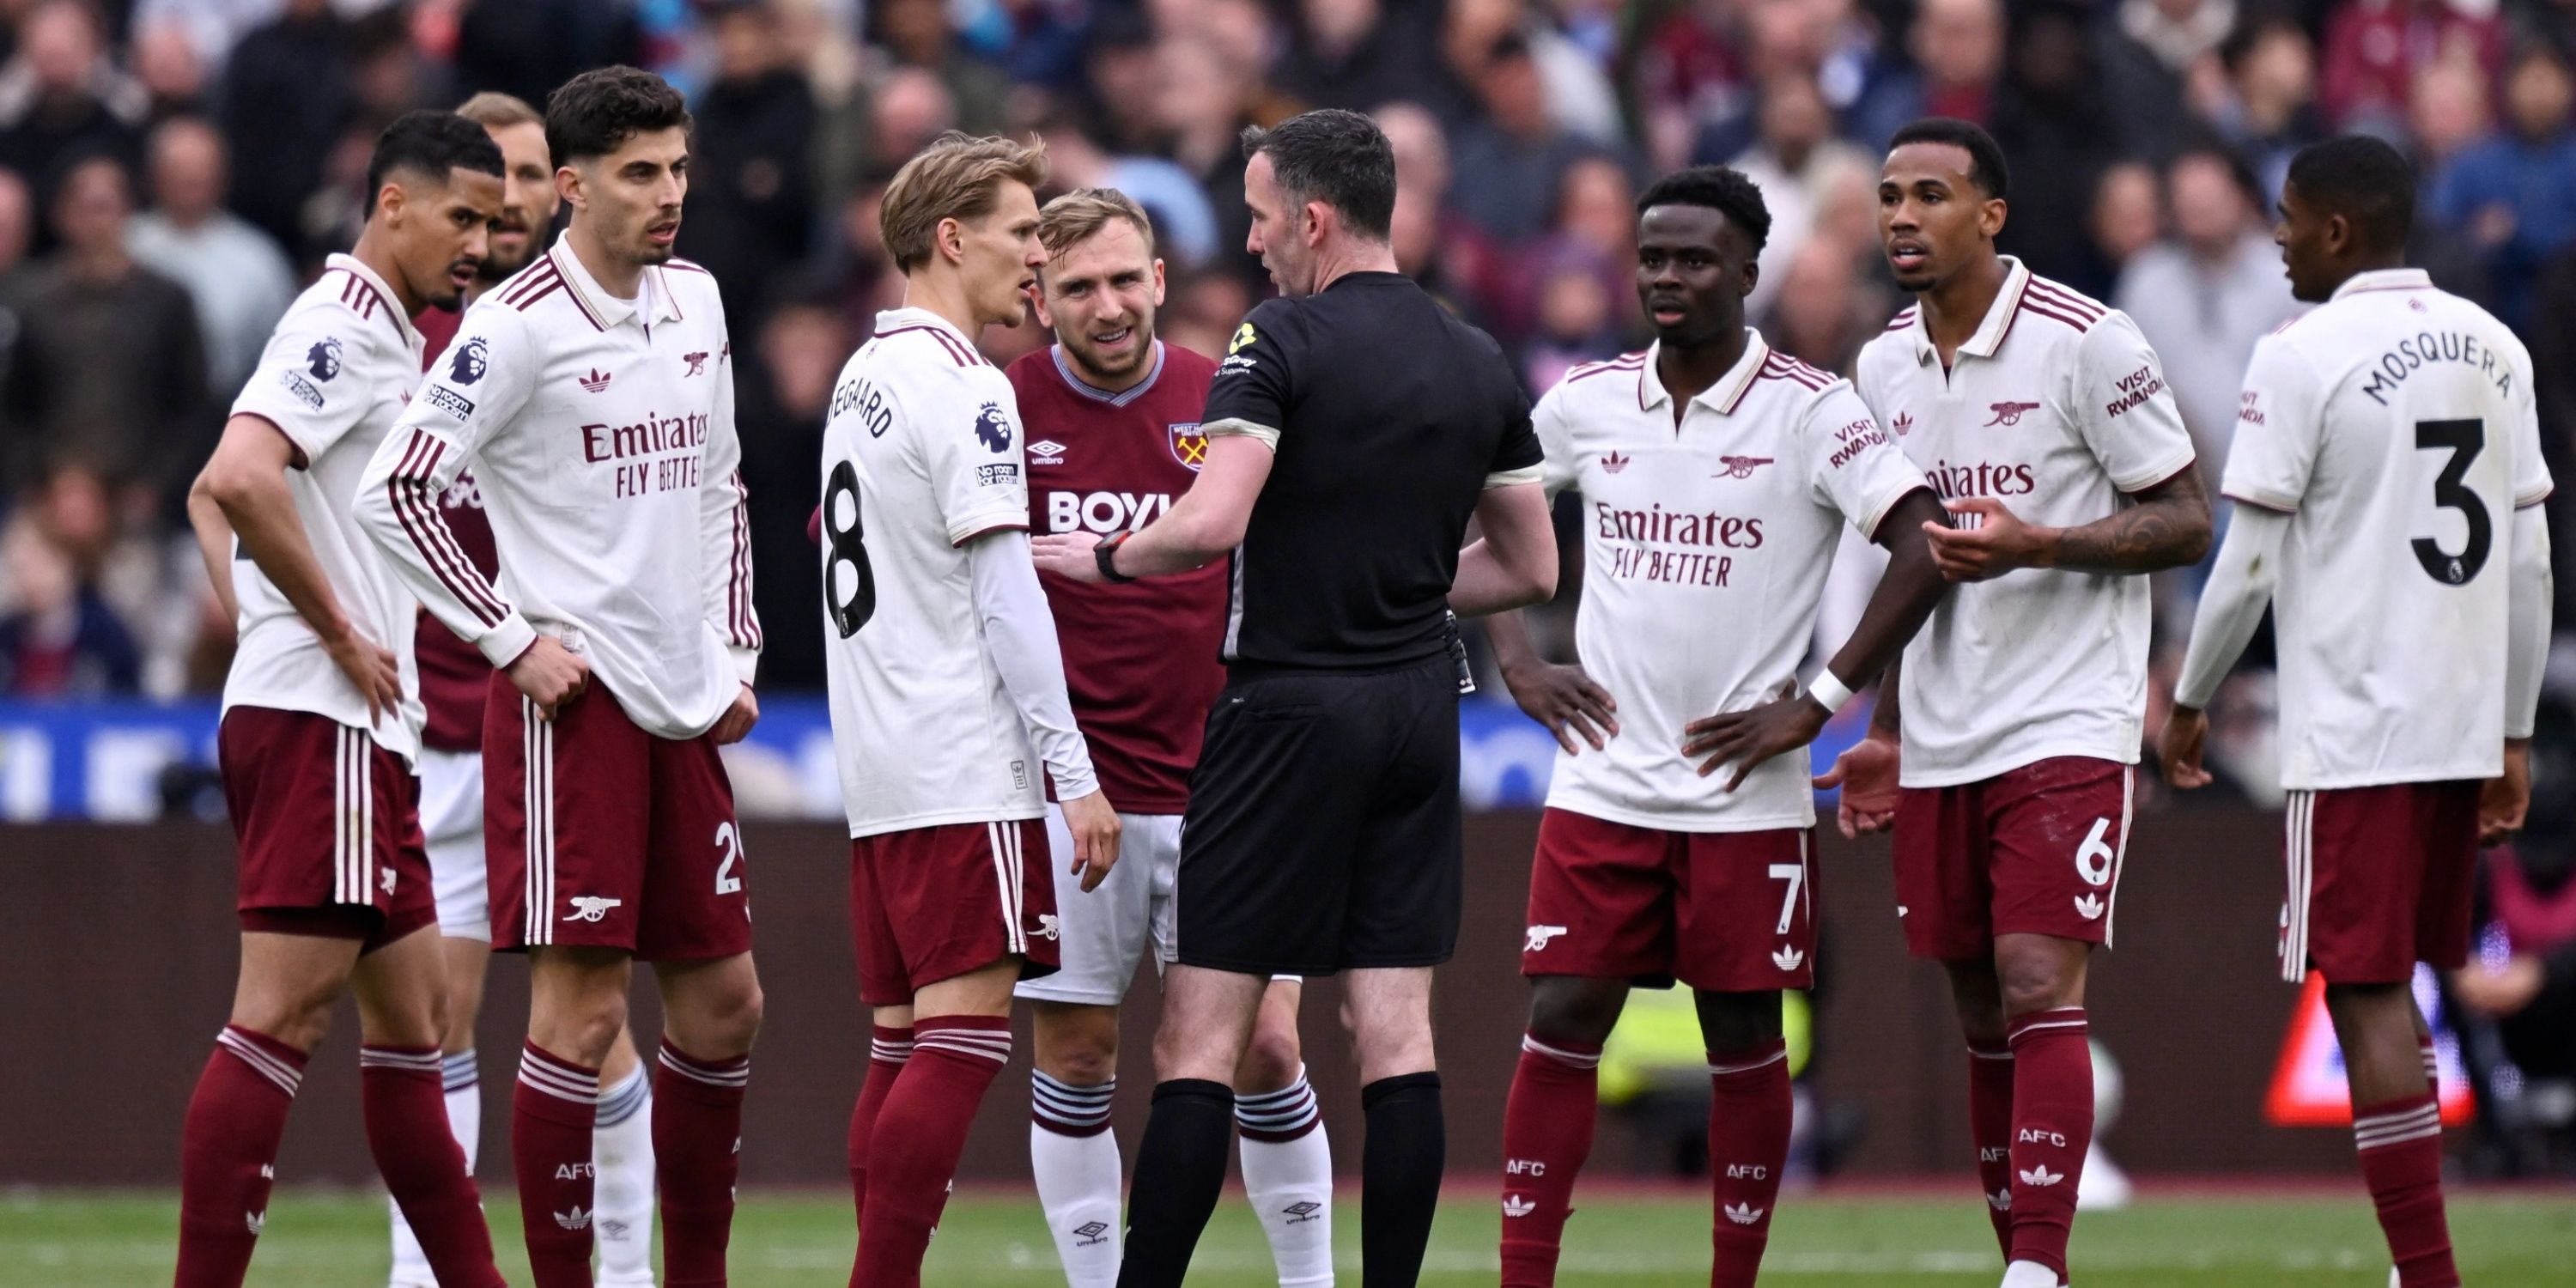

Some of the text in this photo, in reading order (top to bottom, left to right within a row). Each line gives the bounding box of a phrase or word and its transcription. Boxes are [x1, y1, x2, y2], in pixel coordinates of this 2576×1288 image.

[2116, 365, 2151, 392] VISIT
[2362, 331, 2512, 407] MOSQUERA
[430, 384, 470, 412] No room
[2107, 376, 2164, 418] RWANDA
[1834, 419, 1874, 441] VISIT
[617, 456, 701, 499] FLY BETTE
[2411, 418, 2494, 586] 3
[1597, 502, 1763, 549] Emirates
[824, 460, 876, 639] 8
[1612, 548, 1732, 587] FLY BETTER
[2076, 817, 2113, 885] 6
[1769, 864, 1802, 934] 7
[2020, 1127, 2066, 1147] AFC
[1507, 1158, 1545, 1176] AFC
[1727, 1163, 1766, 1180] AFC
